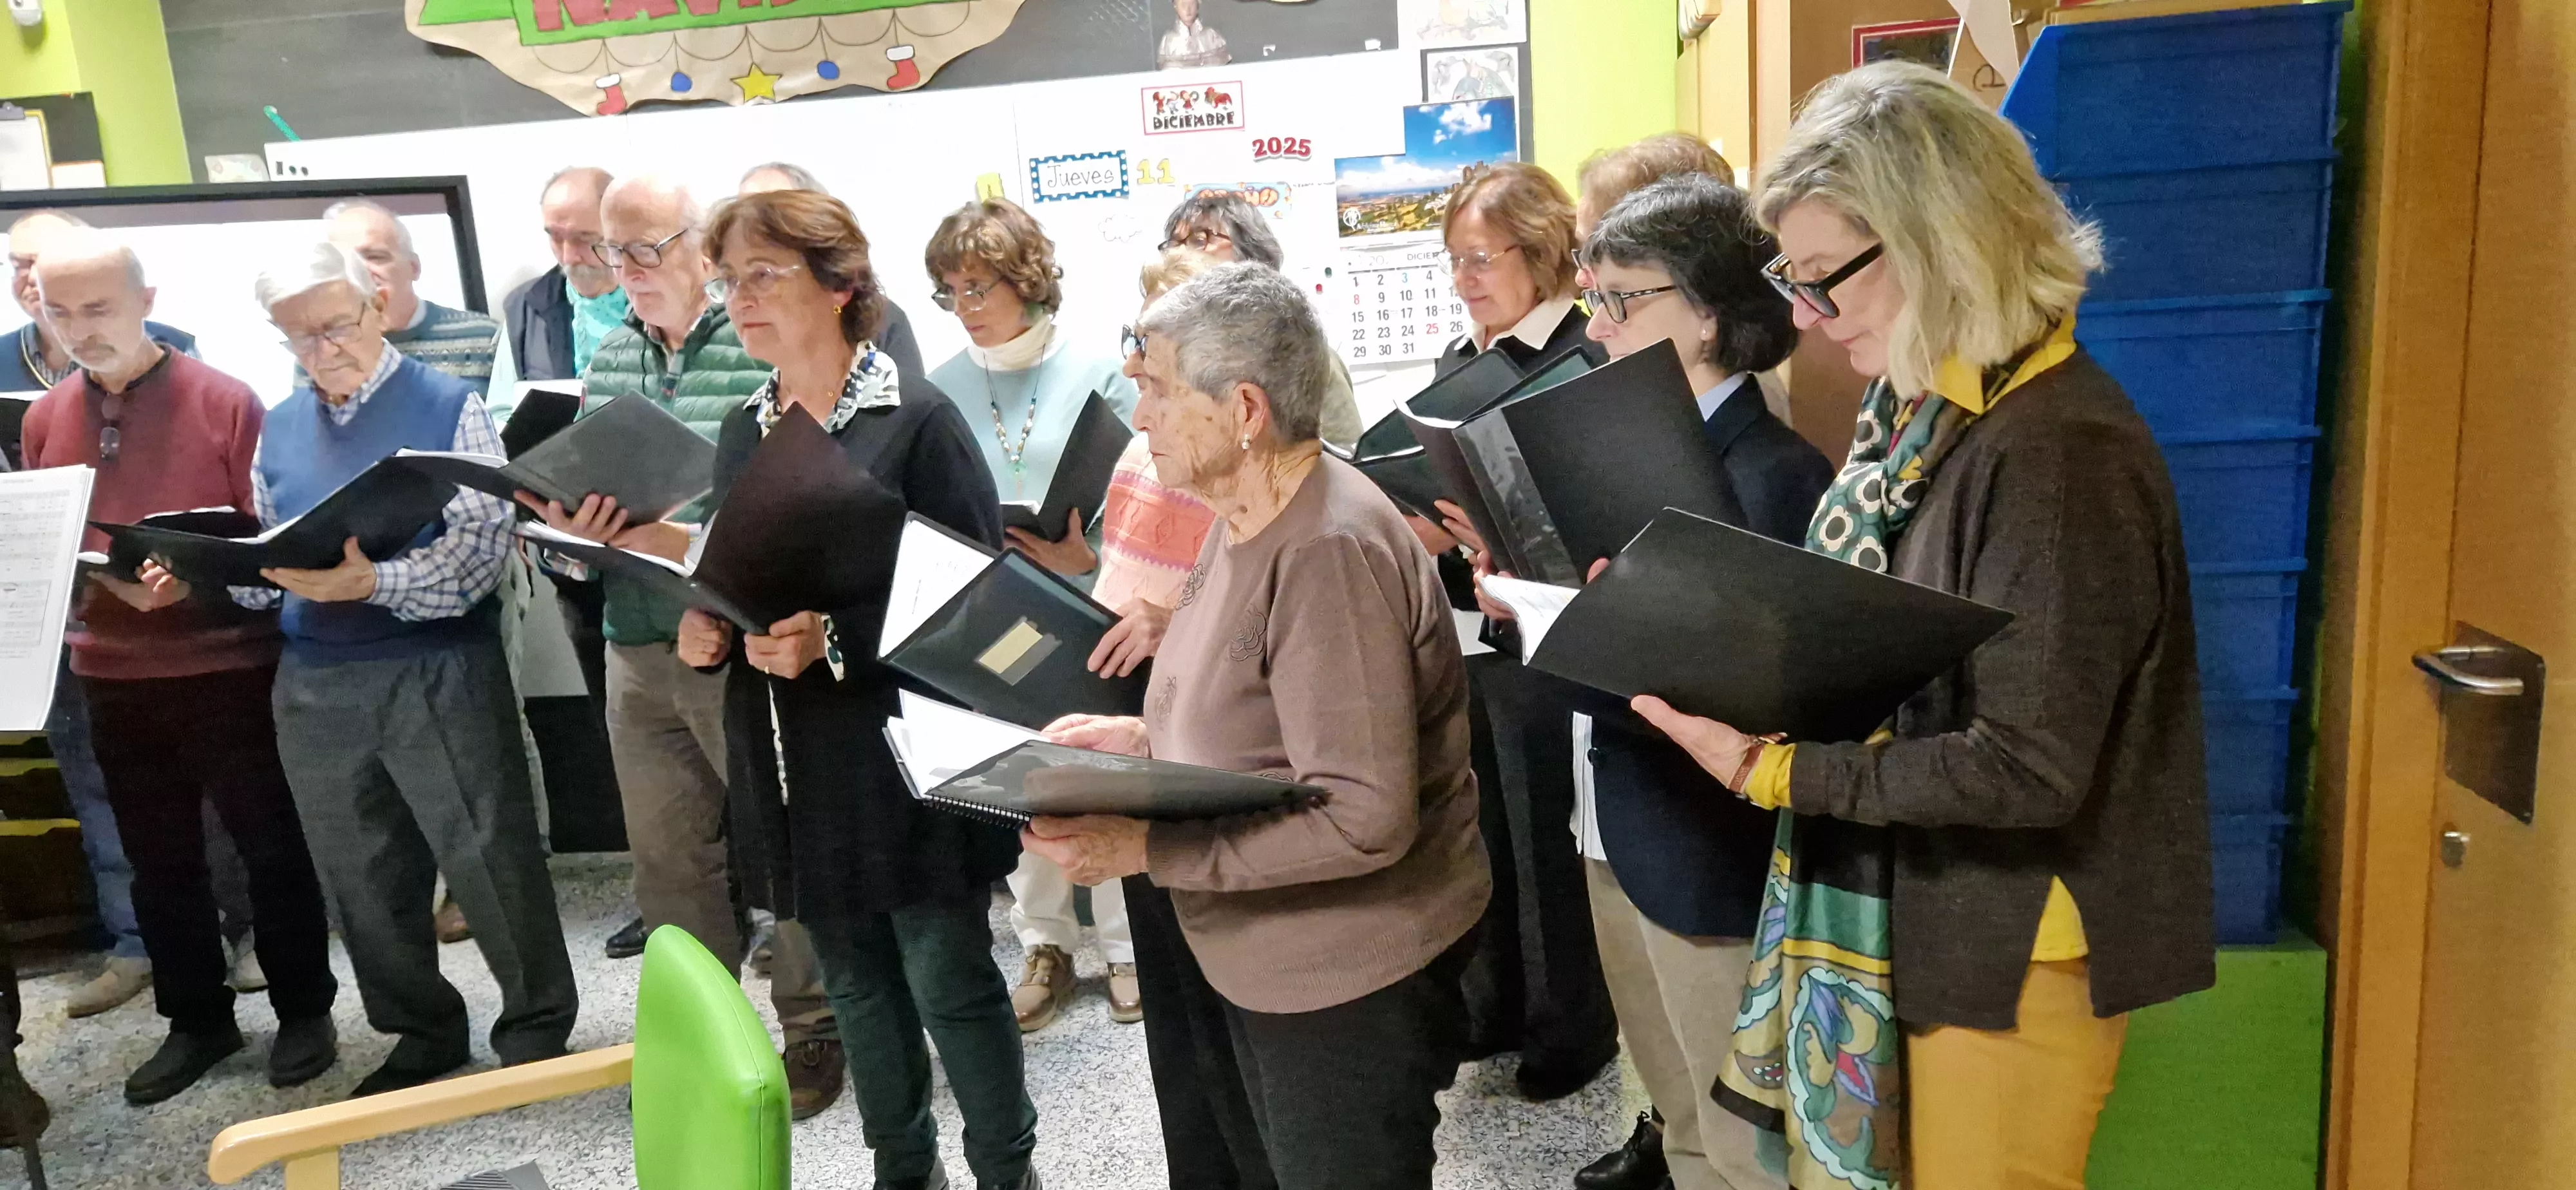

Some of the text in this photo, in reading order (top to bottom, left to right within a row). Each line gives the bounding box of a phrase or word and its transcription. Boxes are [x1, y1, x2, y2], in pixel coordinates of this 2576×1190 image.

[1153, 111, 1234, 129] DICIEMBRE
[1252, 137, 1311, 158] 2025
[1046, 164, 1115, 187] Jueves
[1137, 158, 1175, 185] 11
[1407, 252, 1437, 261] DICIE
[1353, 270, 1433, 287] 1 2 3 4
[1354, 294, 1359, 305] 8
[1378, 292, 1385, 303] 9
[1400, 290, 1412, 301] 10
[1425, 288, 1436, 299] 11
[1352, 303, 1462, 323] 15 16 17 18 19
[1353, 321, 1463, 340] 22 23 24 25 26
[1354, 343, 1414, 357] 29 30 31
